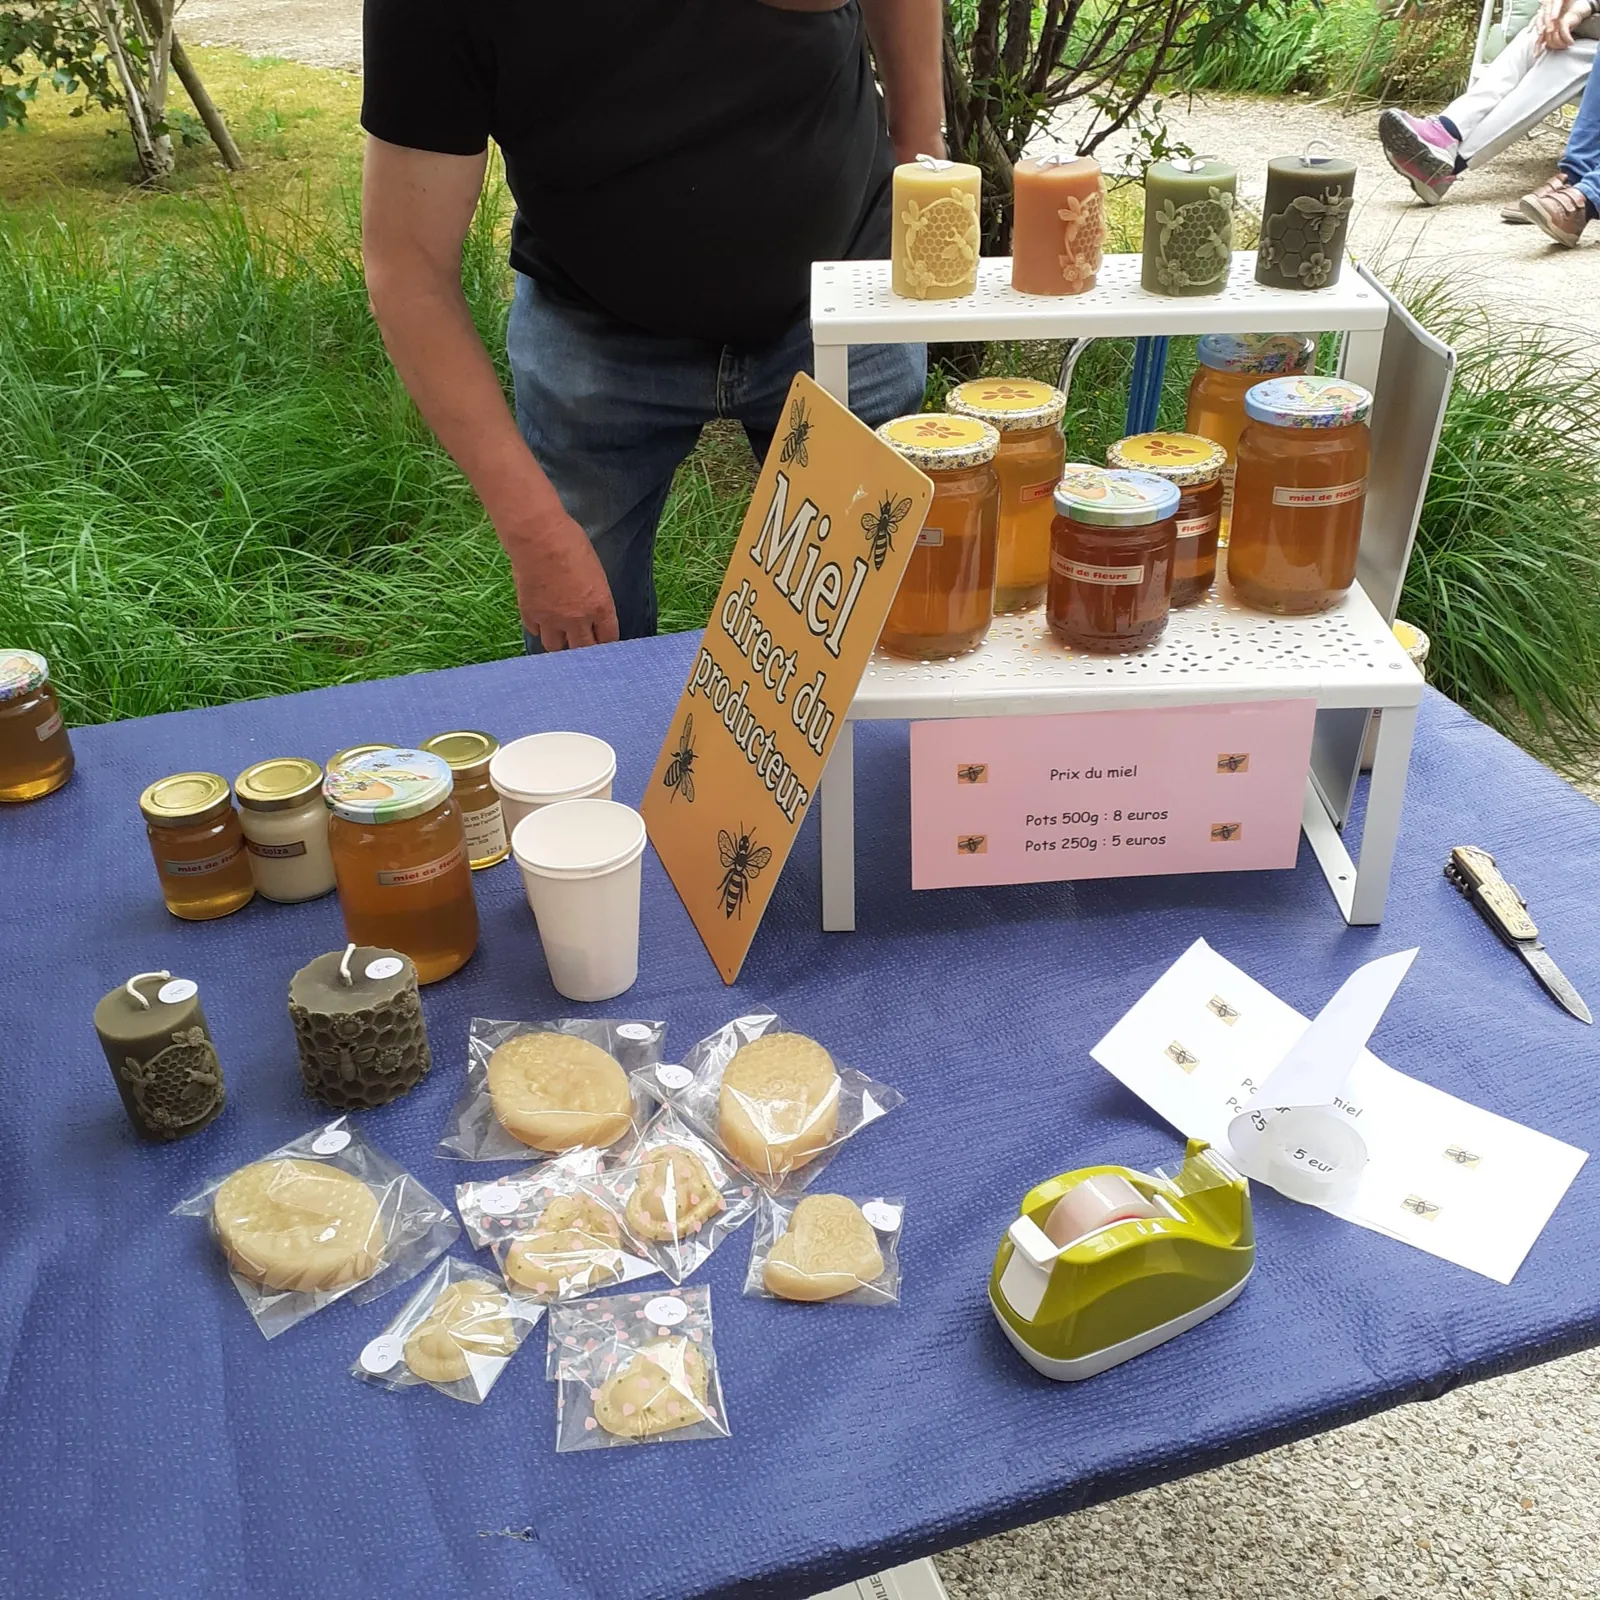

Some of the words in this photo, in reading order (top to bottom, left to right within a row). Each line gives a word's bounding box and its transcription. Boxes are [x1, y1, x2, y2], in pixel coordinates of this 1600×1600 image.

[1288, 494, 1316, 502] miel
[1318, 494, 1333, 502] de
[1181, 522, 1210, 533] fleurs
[749, 469, 870, 659] Miel
[1056, 561, 1074, 573] miel
[1076, 568, 1090, 577] de
[1092, 571, 1128, 580] fleurs
[721, 578, 798, 703] direct
[791, 670, 835, 756] du
[687, 647, 809, 824] producteur
[1050, 769, 1081, 781] Prix
[1085, 767, 1103, 779] du
[1107, 765, 1138, 778] miel
[1026, 814, 1058, 826] Pots
[1062, 811, 1099, 826] 500g
[1113, 810, 1123, 822] 8
[1127, 810, 1169, 821] euros
[1025, 839, 1057, 852] Pots
[1061, 837, 1098, 852] 250g
[1111, 835, 1121, 847] 5
[1125, 835, 1167, 846] euros
[177, 864, 202, 873] miel
[204, 861, 219, 870] de
[393, 872, 419, 882] miel
[422, 868, 437, 877] de
[1293, 1148, 1308, 1160] 5
[1308, 1158, 1334, 1173] eur
